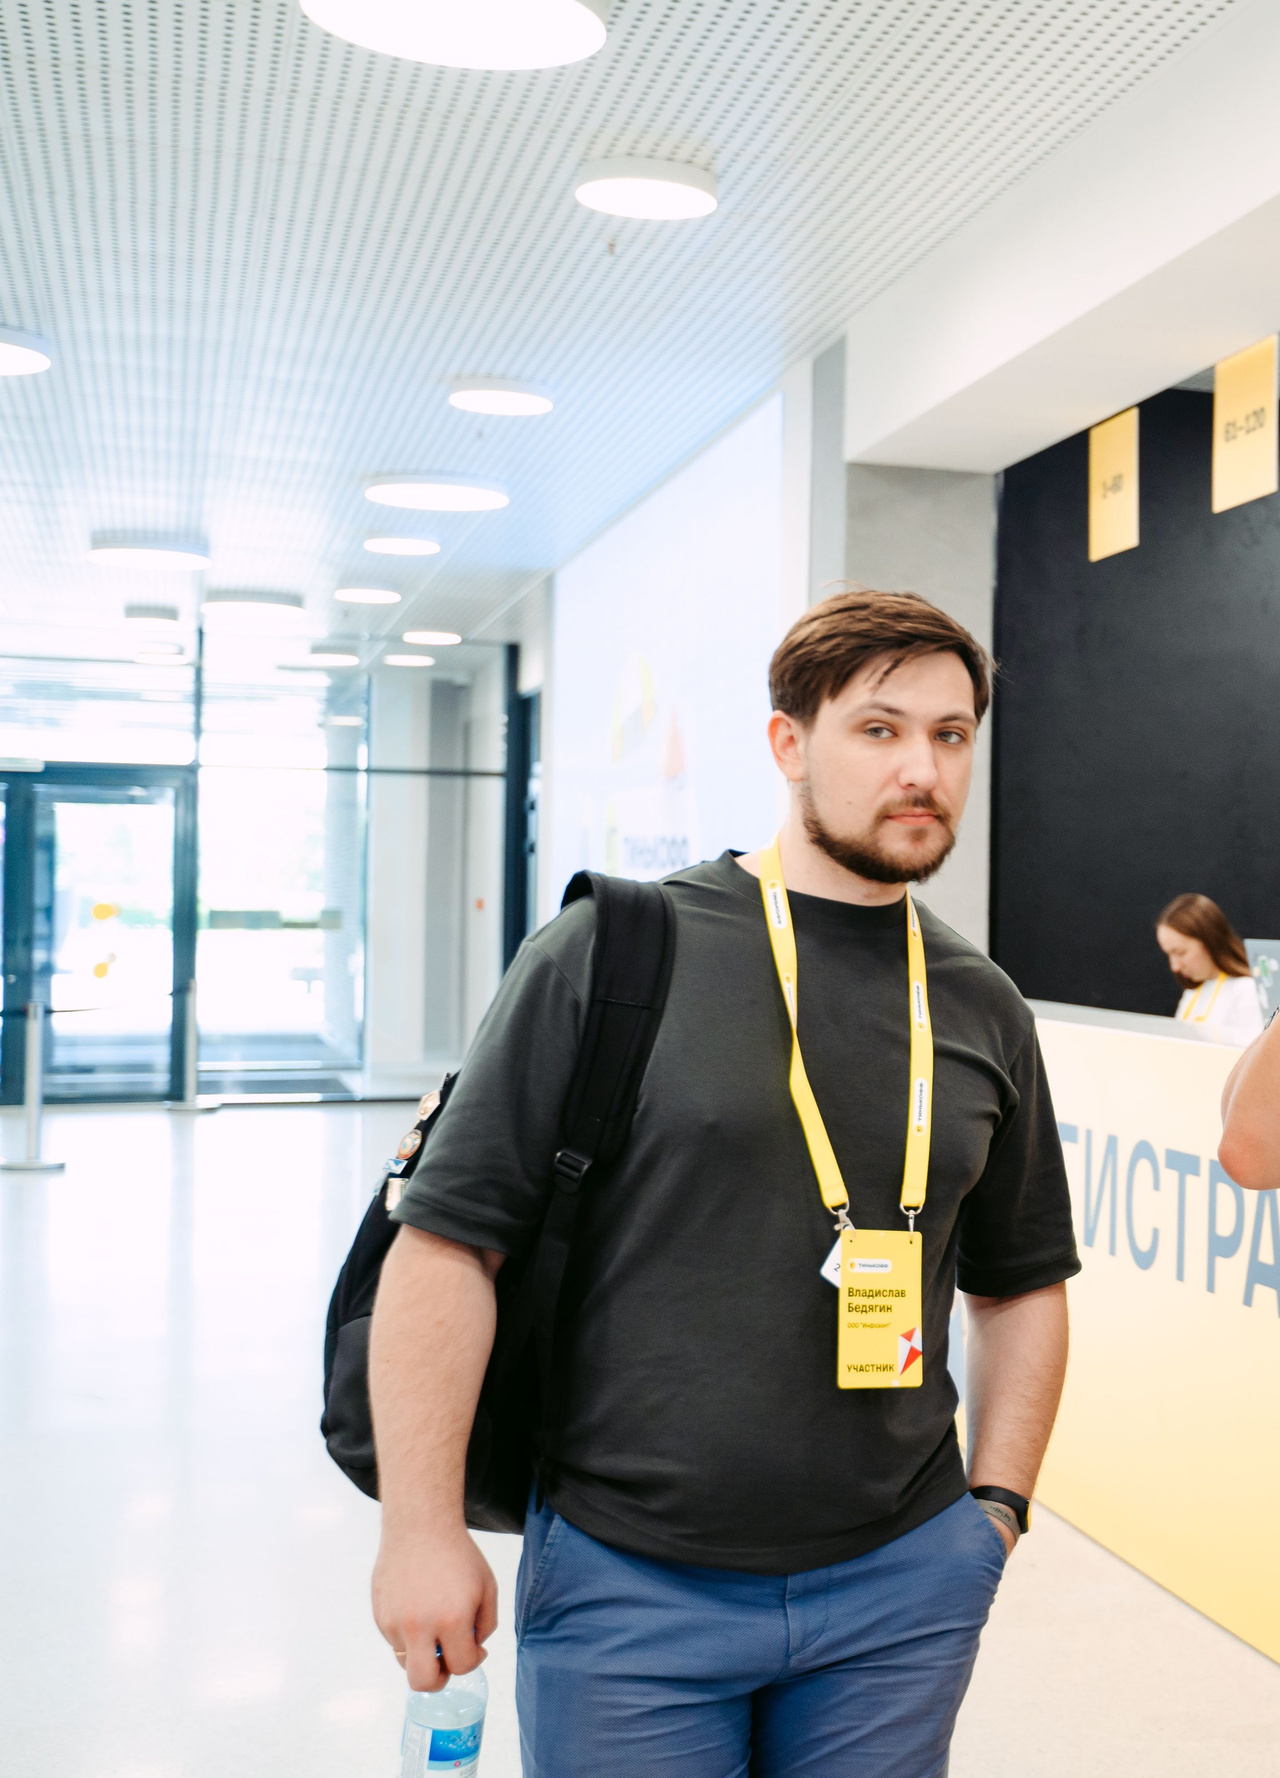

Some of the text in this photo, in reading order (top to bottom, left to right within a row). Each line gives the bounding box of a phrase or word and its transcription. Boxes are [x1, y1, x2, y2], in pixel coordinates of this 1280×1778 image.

[847, 1287, 906, 1299] Владислав
[847, 1302, 893, 1314] Бедягин
[847, 1364, 895, 1373] УЧАСТНИК
